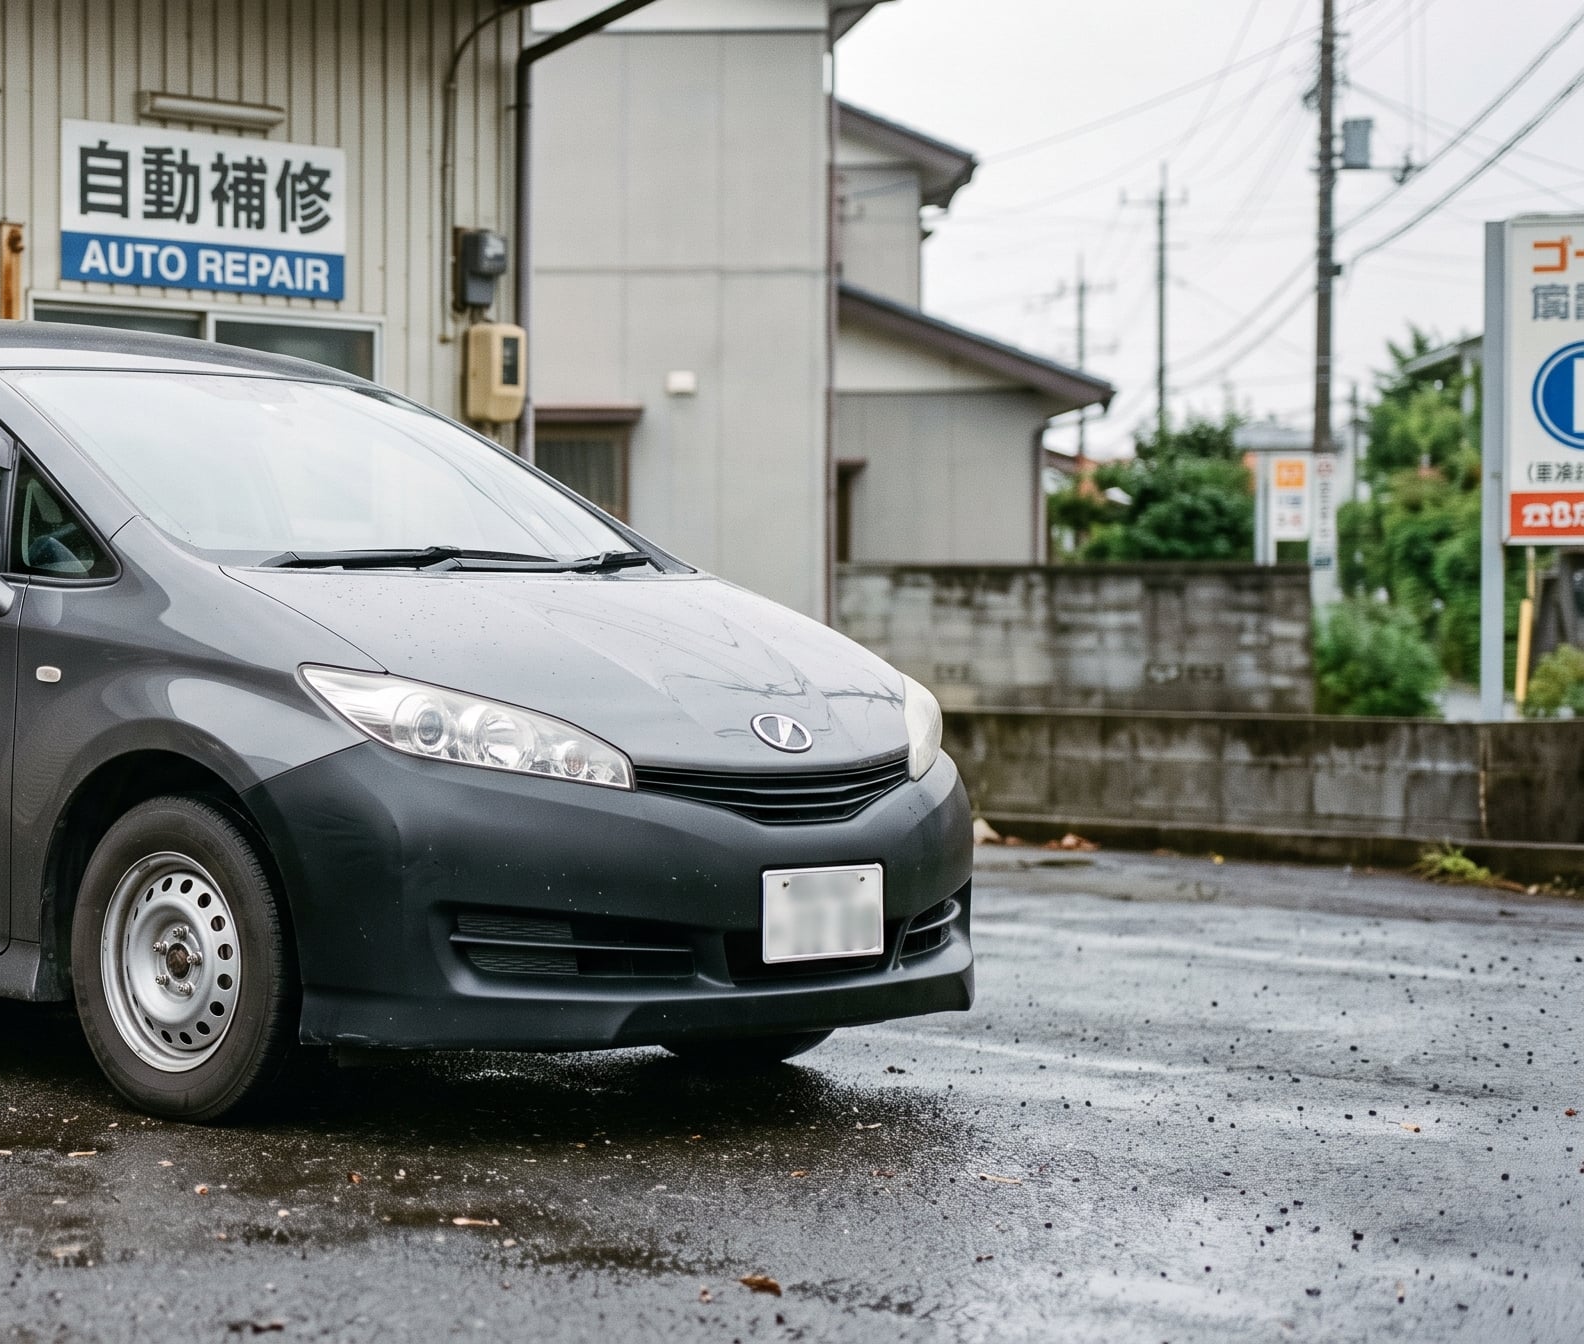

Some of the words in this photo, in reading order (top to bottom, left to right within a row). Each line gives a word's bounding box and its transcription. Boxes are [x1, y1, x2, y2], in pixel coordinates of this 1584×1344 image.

[78, 139, 332, 235] 自動補修
[79, 239, 187, 281] AUTO
[198, 249, 330, 292] REPAIR
[1532, 235, 1584, 274] ゴ
